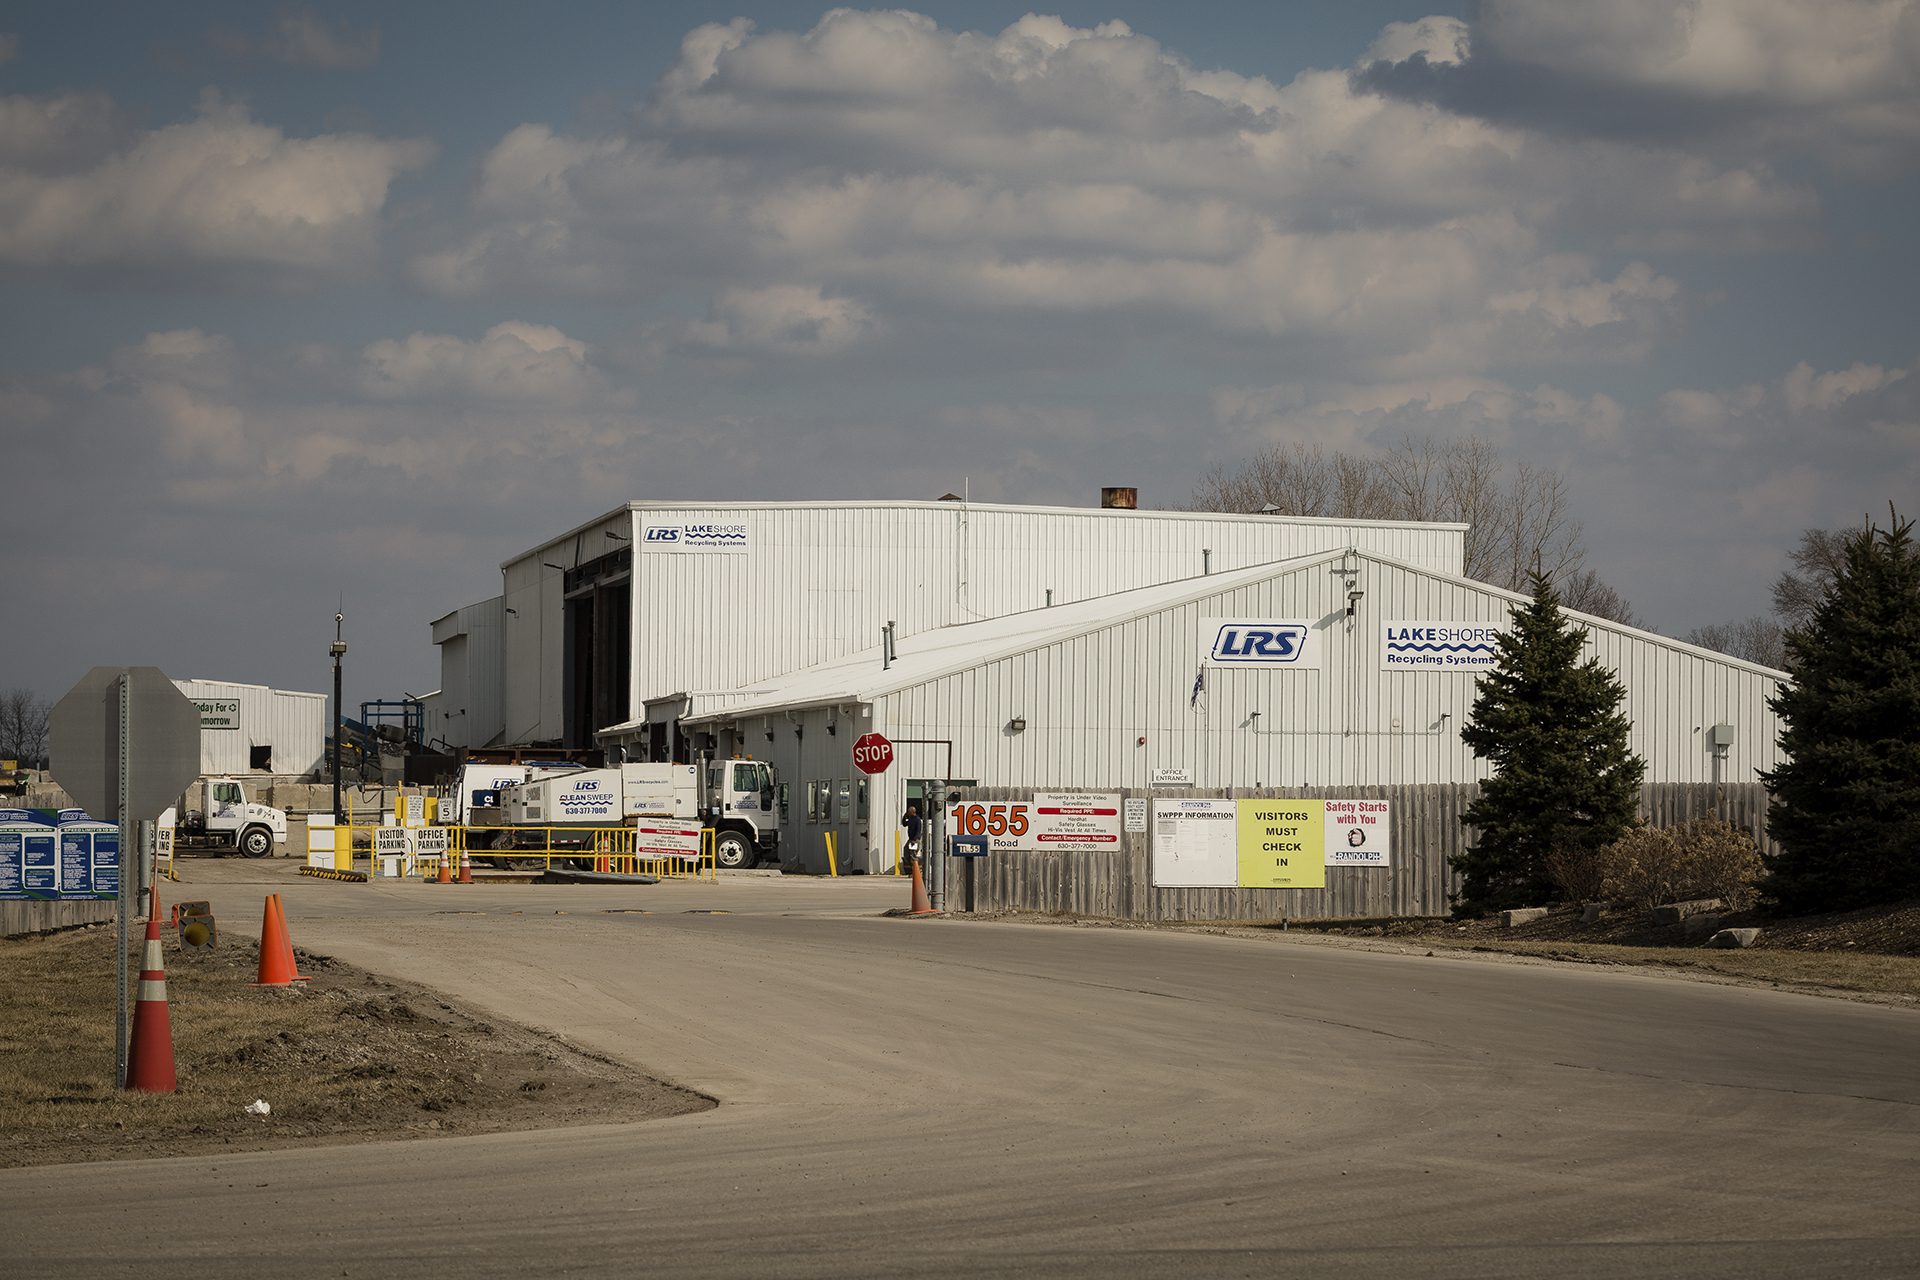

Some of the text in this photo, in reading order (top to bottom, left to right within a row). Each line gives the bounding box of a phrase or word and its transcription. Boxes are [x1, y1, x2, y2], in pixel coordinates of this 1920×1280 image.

[647, 530, 678, 540] LRS
[1388, 628, 1495, 641] LAKESHORE
[1220, 631, 1298, 656] LRS
[1388, 654, 1495, 665] Recycling Systems
[216, 702, 226, 712] For
[856, 744, 890, 762] STOP
[575, 782, 598, 790] LRS
[1326, 802, 1387, 812] Safety Starts
[443, 808, 450, 816] 5
[1255, 812, 1308, 821] VISITORS
[952, 804, 1029, 836] 1655
[1337, 814, 1376, 824] with You
[379, 830, 404, 839] VISITOR
[418, 830, 444, 839] OFFICE
[1266, 828, 1298, 836] MUST
[379, 840, 405, 849] PARKING
[418, 840, 444, 849] PARKING
[1262, 843, 1302, 851] CHECK
